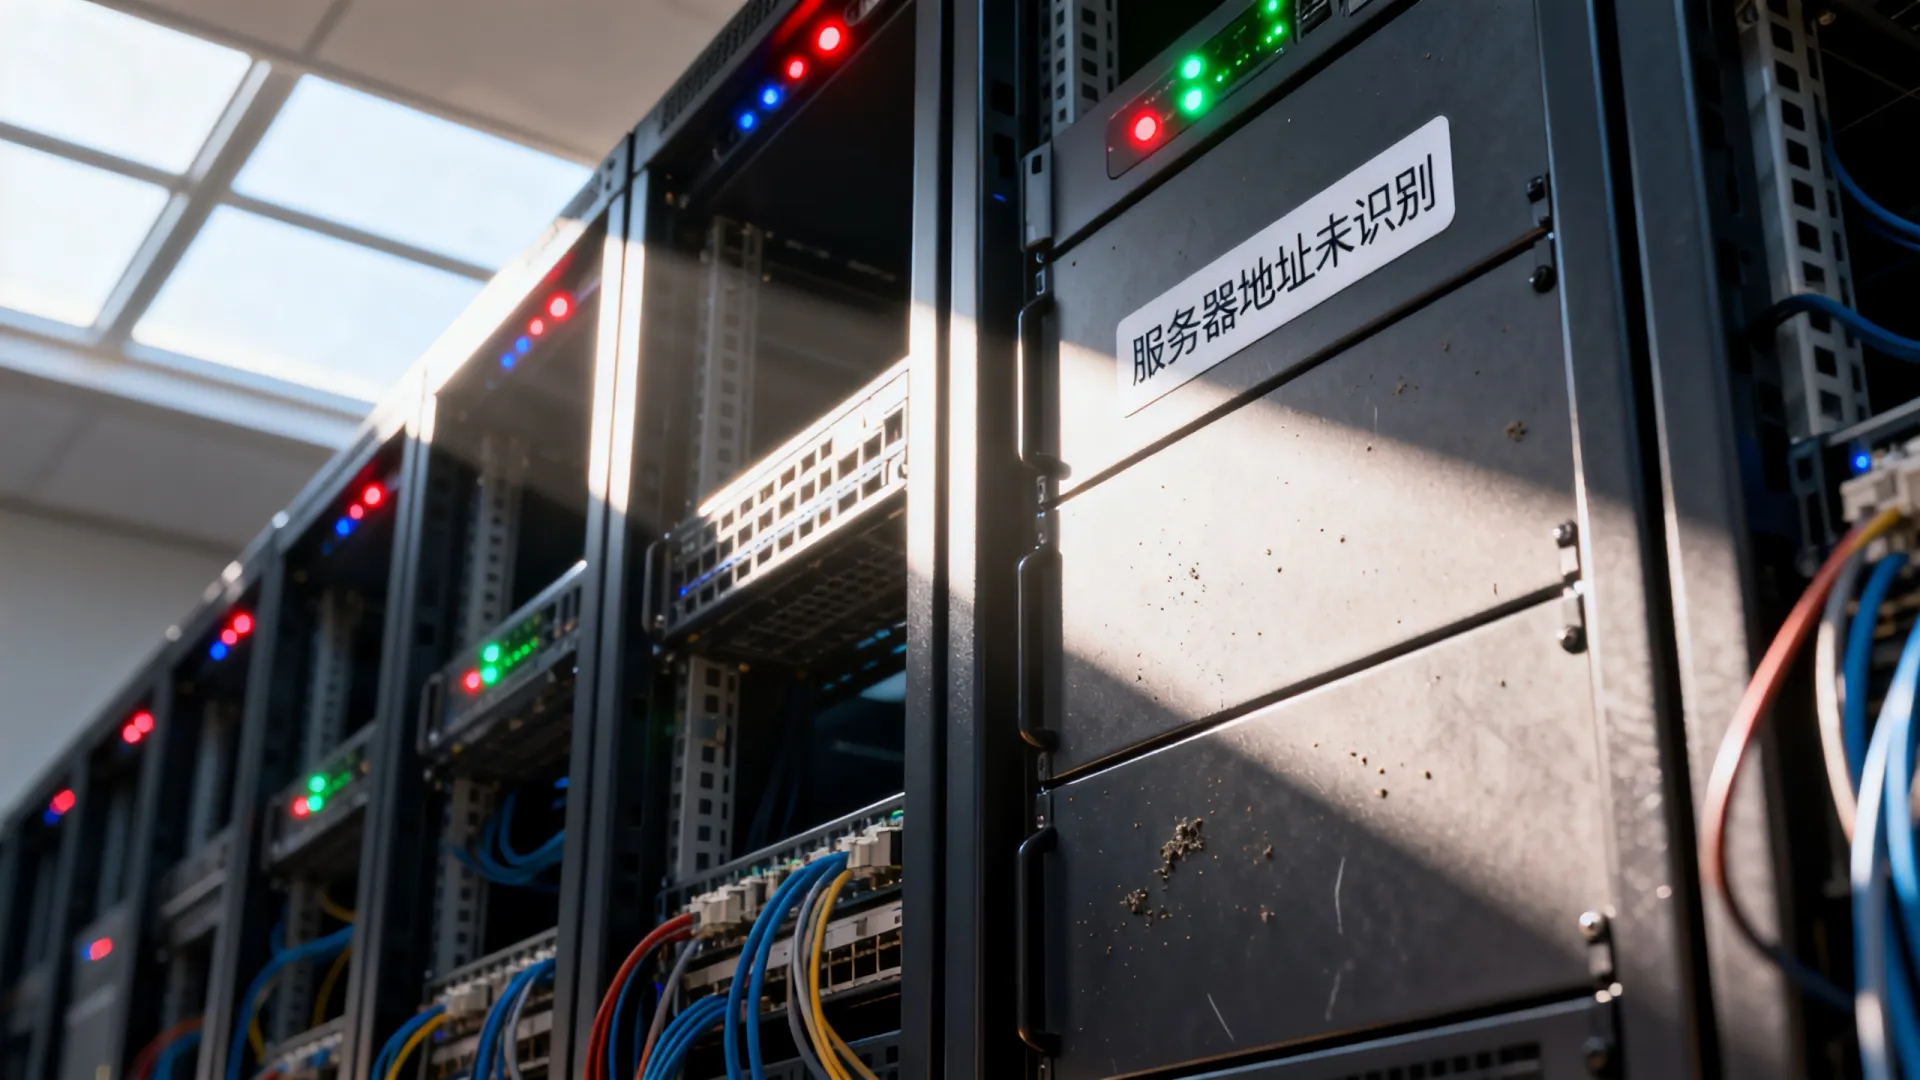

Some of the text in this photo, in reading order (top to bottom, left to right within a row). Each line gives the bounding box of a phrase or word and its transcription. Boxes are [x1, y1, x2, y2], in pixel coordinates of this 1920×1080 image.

[1132, 153, 1436, 386] 服务器地址未识别
